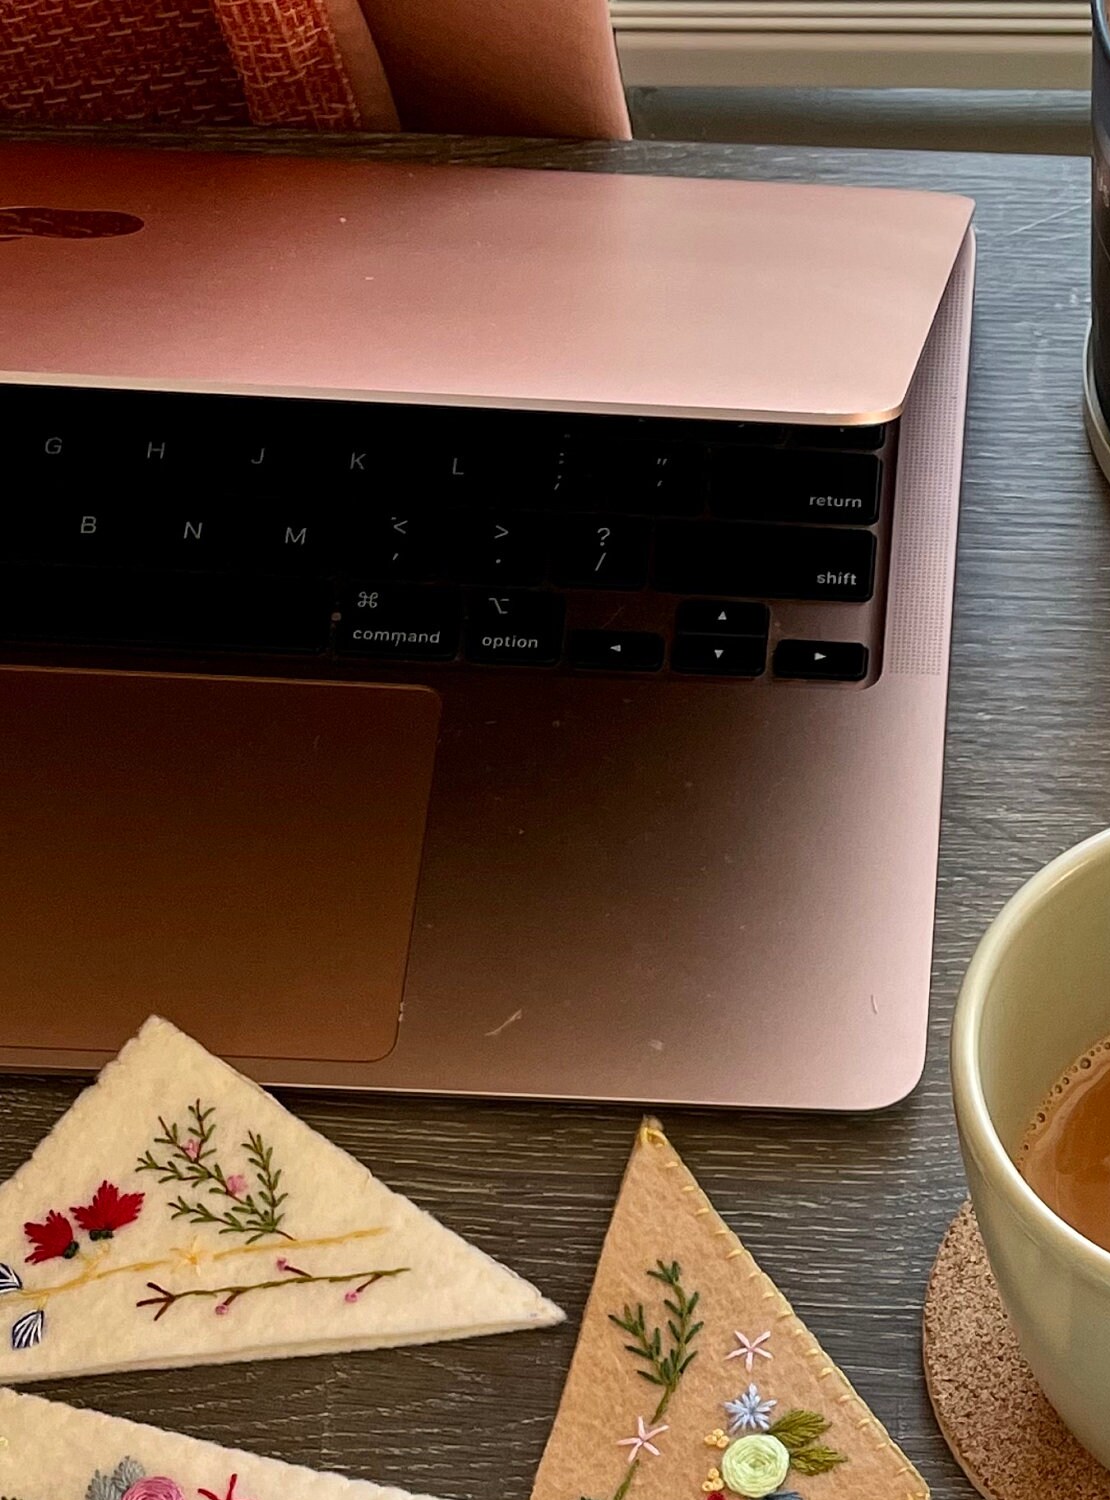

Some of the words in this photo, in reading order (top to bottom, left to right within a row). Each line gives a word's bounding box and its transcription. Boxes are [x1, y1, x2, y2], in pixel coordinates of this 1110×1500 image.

[45, 437, 62, 454] G
[147, 442, 165, 459] H
[251, 448, 264, 464] J
[350, 453, 366, 469] K
[453, 458, 464, 475] L
[809, 495, 862, 508] return
[81, 516, 96, 533] B
[184, 522, 202, 539] N
[285, 527, 306, 544] M
[816, 571, 857, 586] shift
[353, 629, 440, 644] command
[482, 635, 538, 649] option
